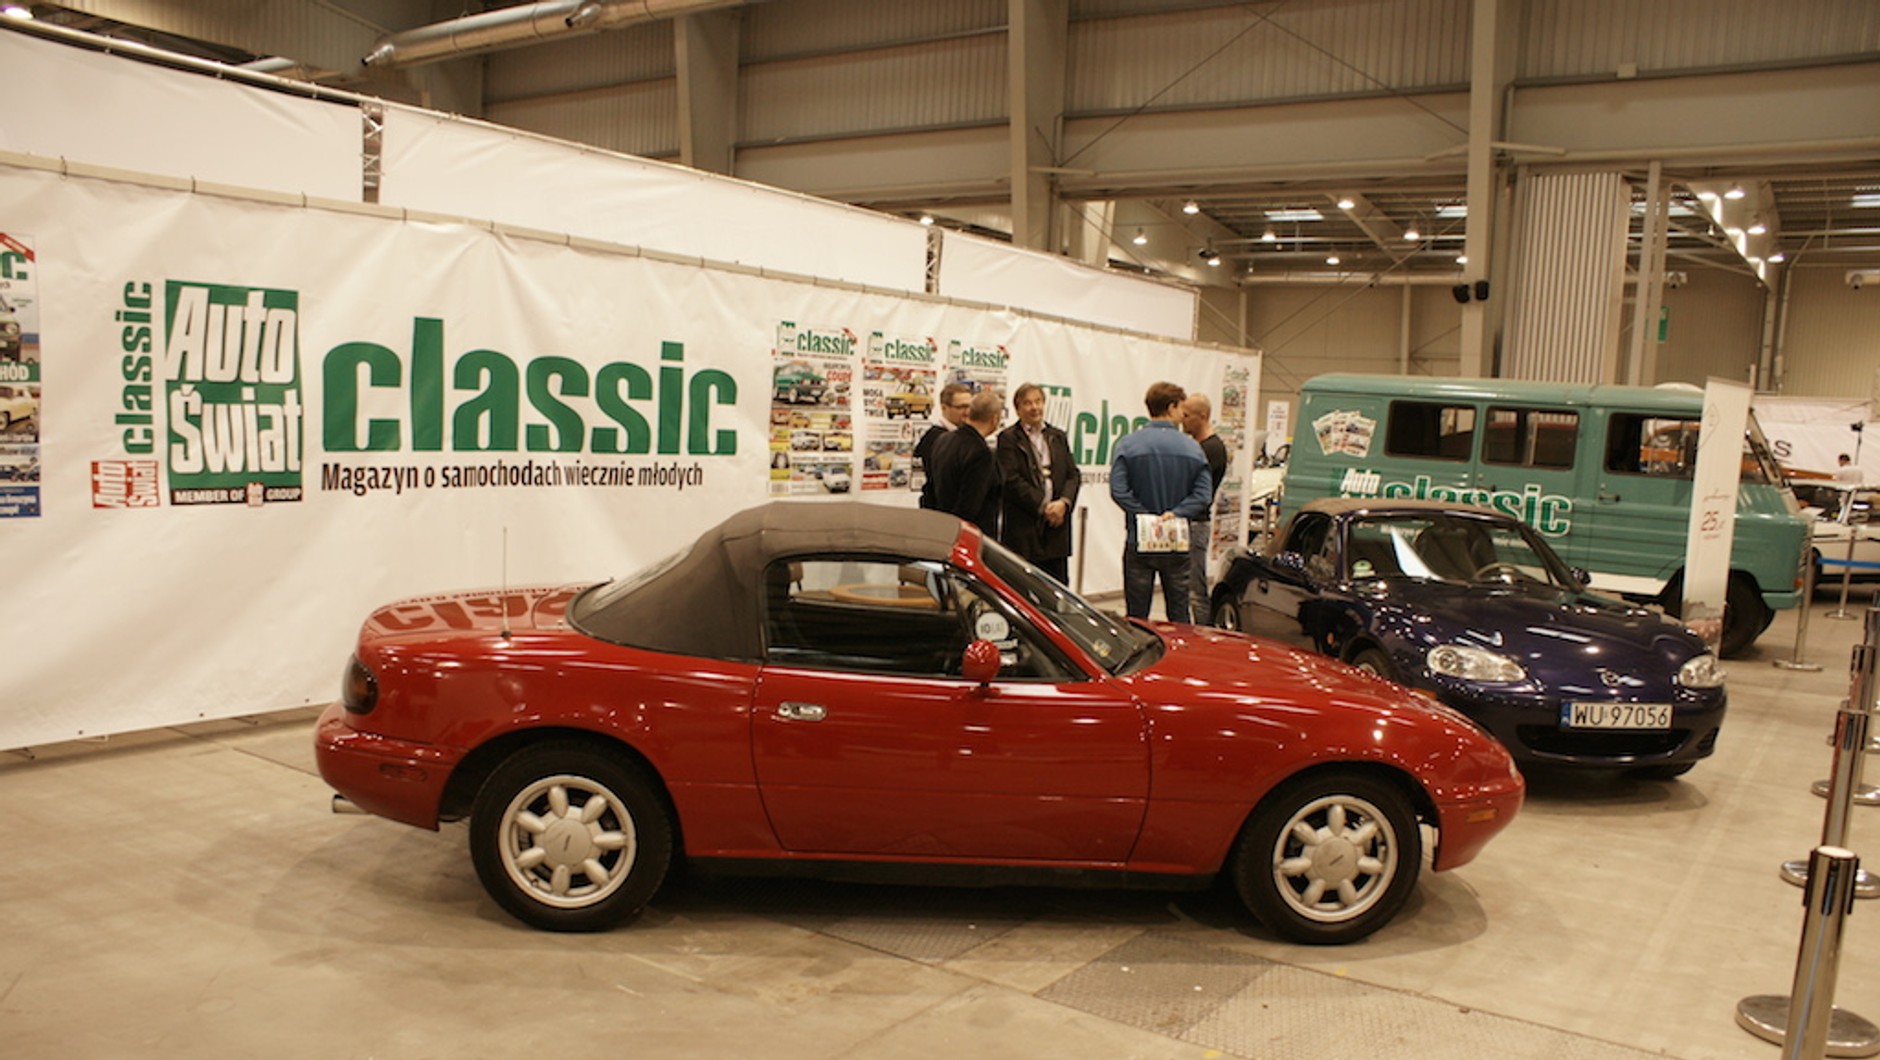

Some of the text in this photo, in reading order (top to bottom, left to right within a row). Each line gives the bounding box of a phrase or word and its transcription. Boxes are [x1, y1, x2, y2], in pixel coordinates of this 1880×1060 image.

[165, 286, 297, 384] Auto
[797, 329, 854, 356] classic
[115, 281, 154, 454] classic
[323, 316, 738, 456] classic
[170, 384, 303, 475] Świat
[175, 489, 229, 504] MEMBER
[230, 489, 246, 503] OF
[266, 487, 302, 500] GROUP
[321, 462, 419, 496] Magazyn
[424, 466, 435, 488] o
[441, 459, 561, 487] samochodach
[637, 461, 704, 491] młodych
[1340, 468, 1382, 495] Auto
[1574, 705, 1669, 726] WU 97056
